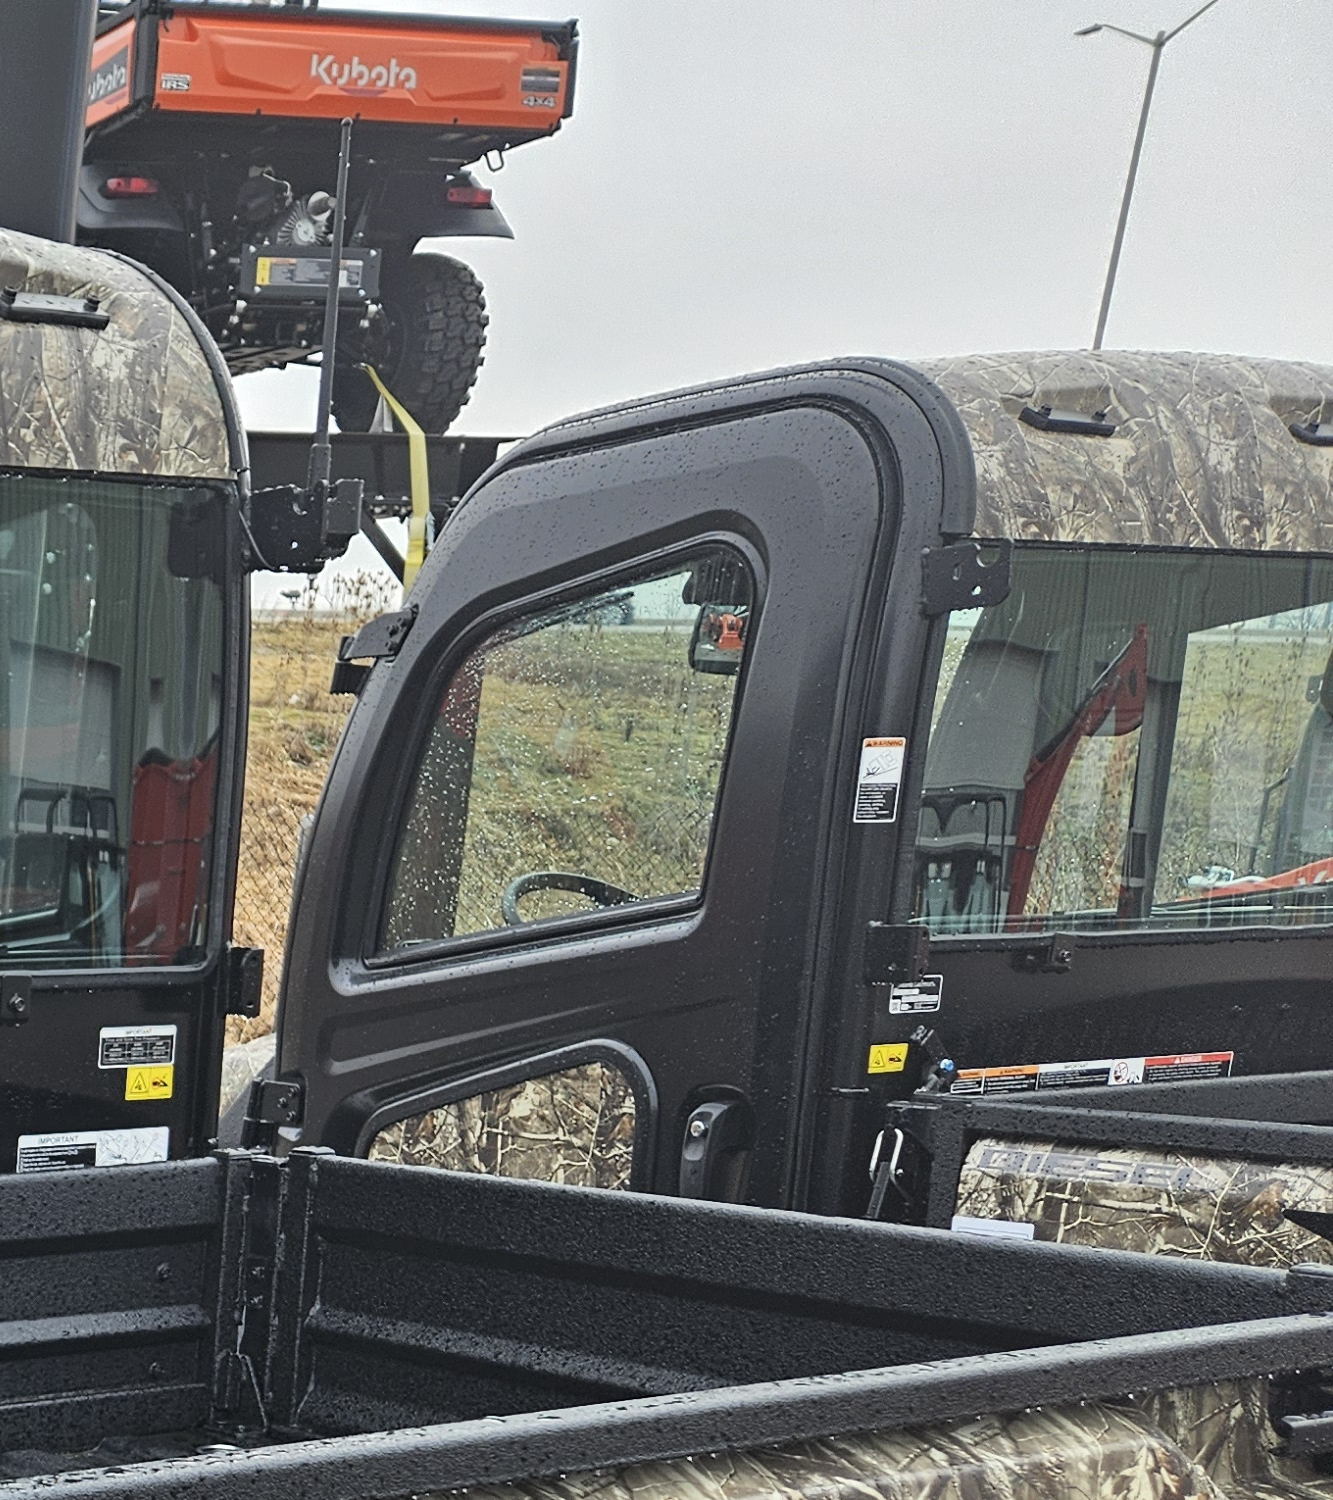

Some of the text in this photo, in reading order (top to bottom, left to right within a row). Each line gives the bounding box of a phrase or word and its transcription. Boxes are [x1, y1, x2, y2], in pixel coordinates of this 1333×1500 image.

[88, 64, 126, 100] ubota
[310, 53, 417, 89] Kubota
[38, 1135, 79, 1144] IMPORTANT
